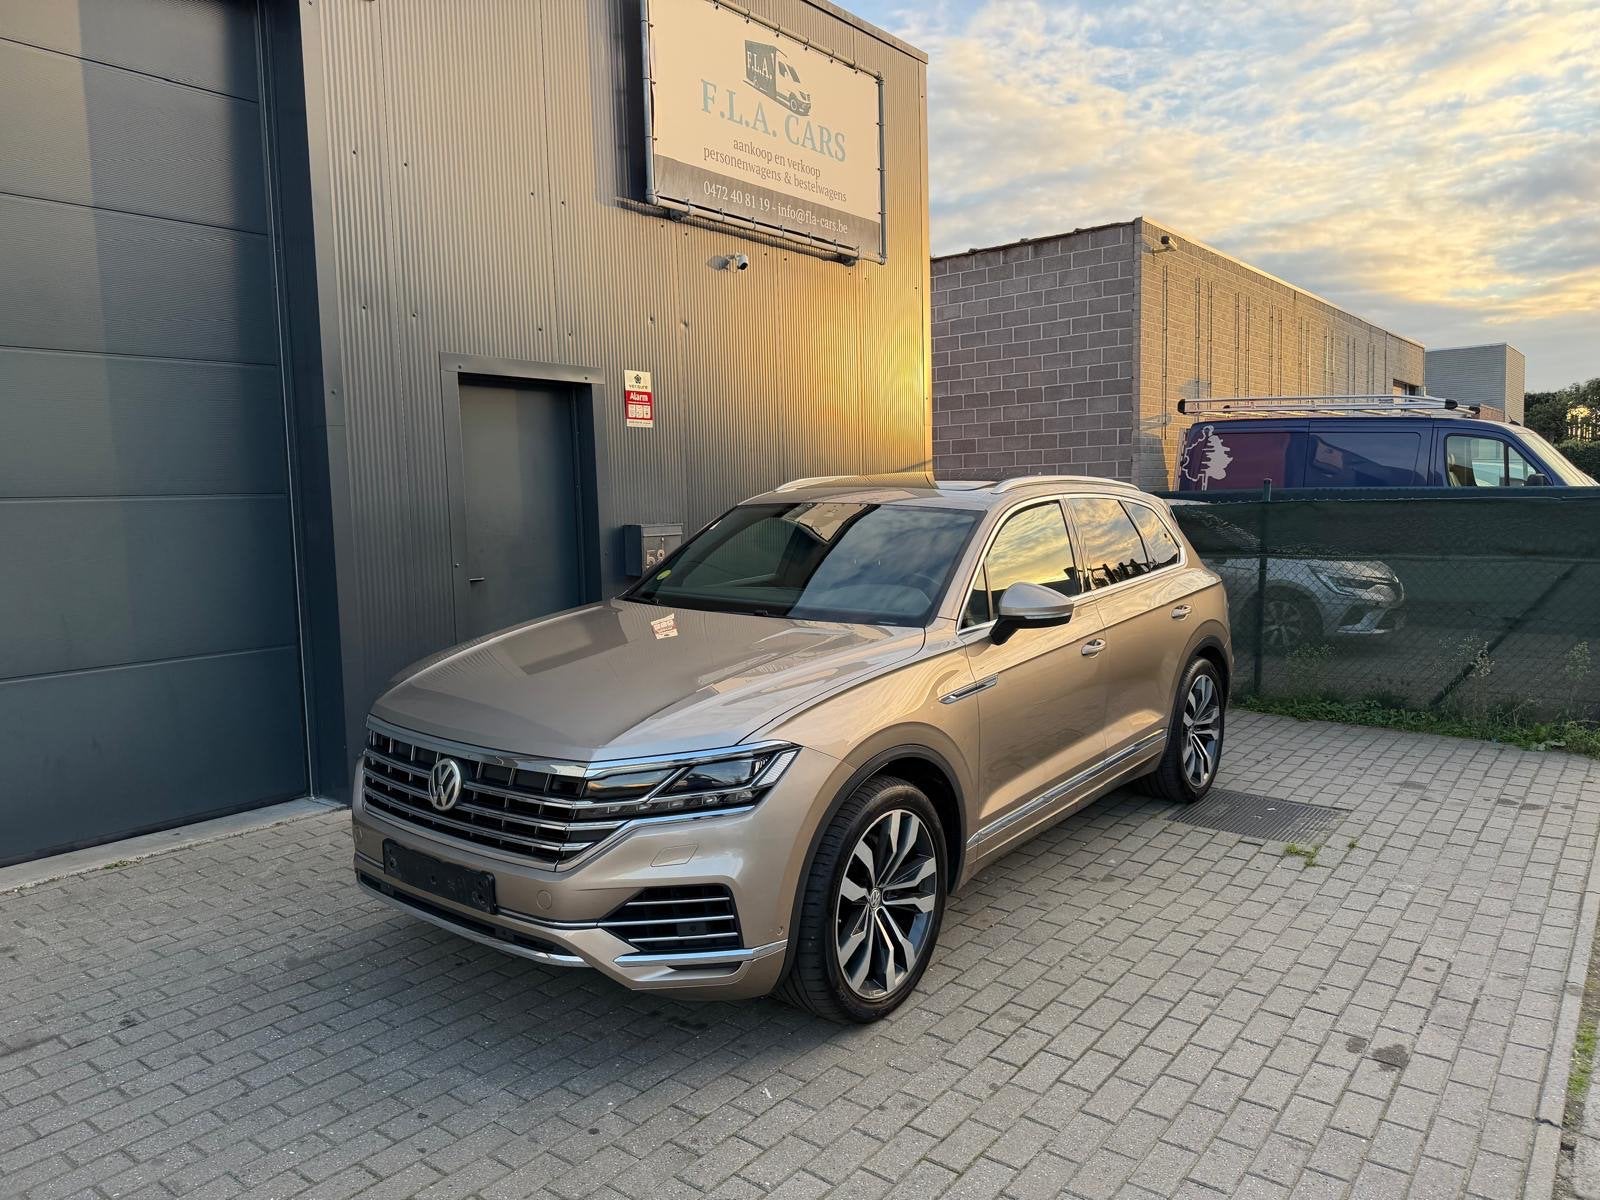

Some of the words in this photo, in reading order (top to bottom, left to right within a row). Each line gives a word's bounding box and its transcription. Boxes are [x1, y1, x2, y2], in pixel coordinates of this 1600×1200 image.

[747, 51, 772, 79] F.L.A.
[701, 78, 777, 137] F.L.A.
[784, 113, 846, 162] CARS
[703, 147, 782, 182] personenwagens
[784, 171, 792, 185] &
[794, 174, 847, 202] bestelwagens
[733, 139, 772, 164] aankoop
[774, 154, 785, 167] en
[787, 158, 821, 180] verkoop
[703, 181, 728, 201] 0472
[730, 189, 743, 204] 40
[745, 193, 756, 208] 81
[759, 198, 770, 212] 19
[778, 202, 848, 234] info@fla-cars.be
[630, 392, 648, 402] Alarm
